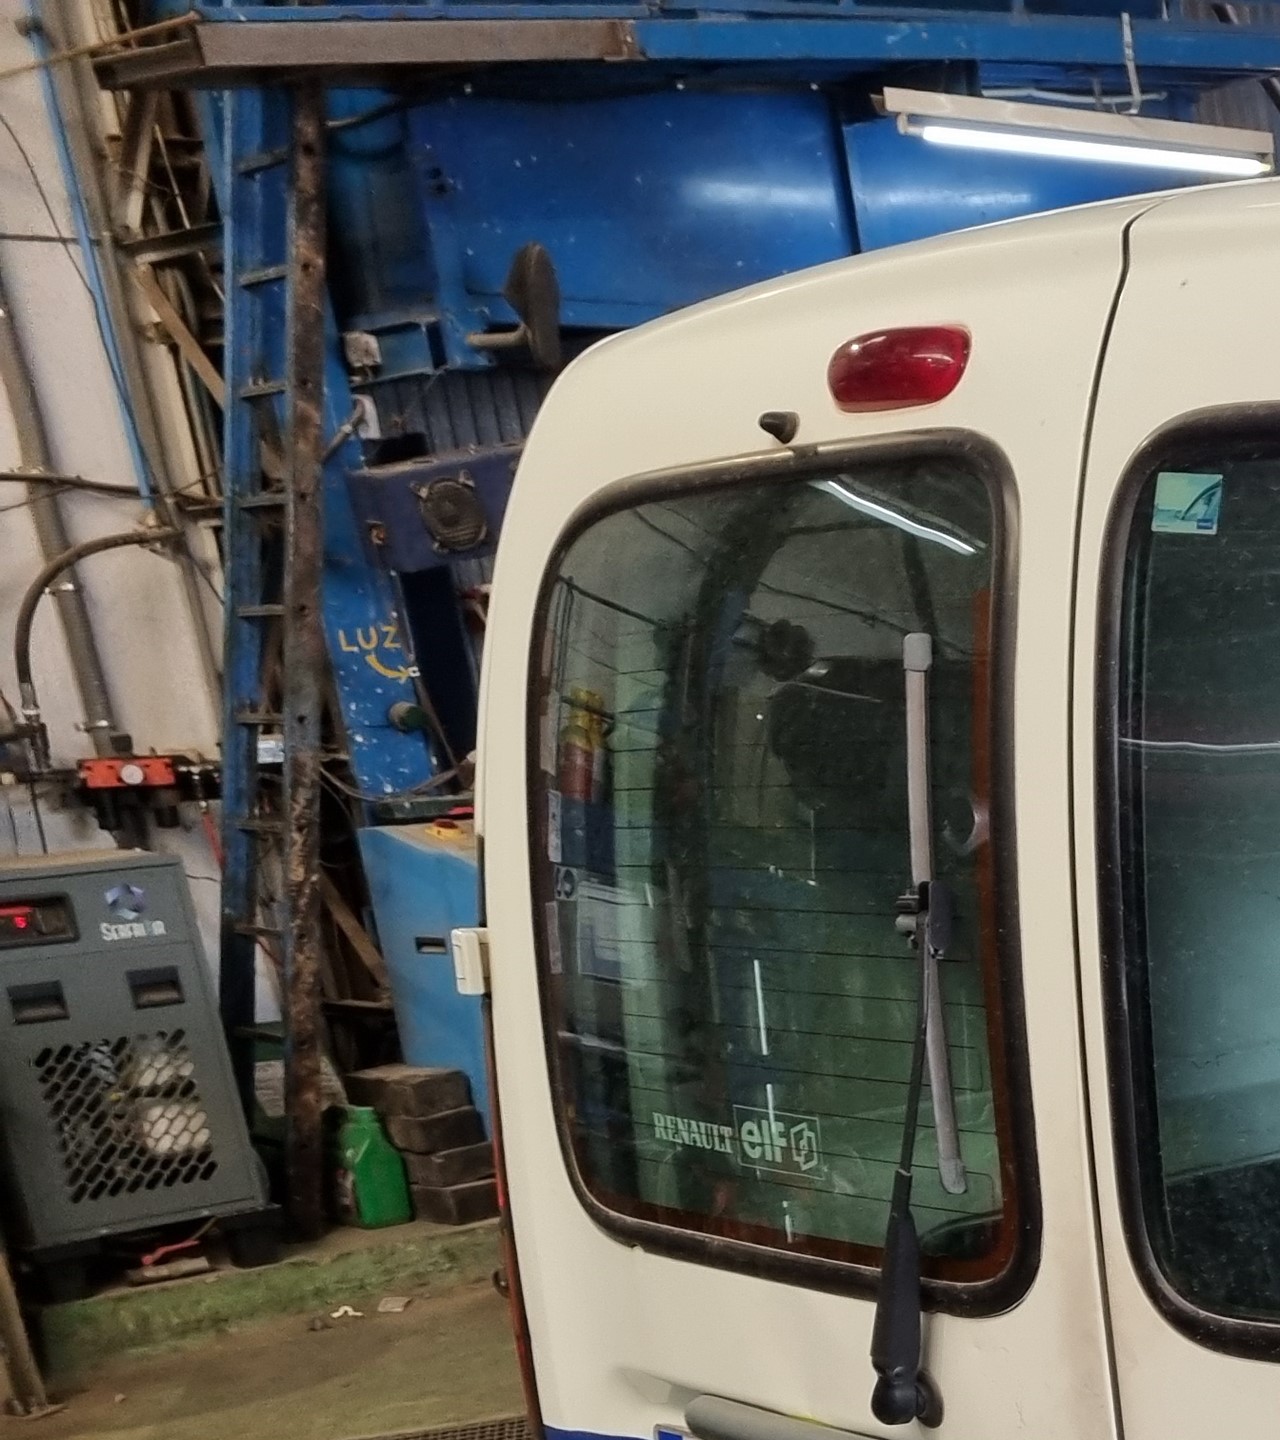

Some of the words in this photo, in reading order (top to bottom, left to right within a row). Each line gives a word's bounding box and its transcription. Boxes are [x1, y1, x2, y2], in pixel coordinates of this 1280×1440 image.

[338, 625, 401, 653] LUZ
[652, 1112, 733, 1154] RENAULT
[740, 1119, 787, 1163] elf
